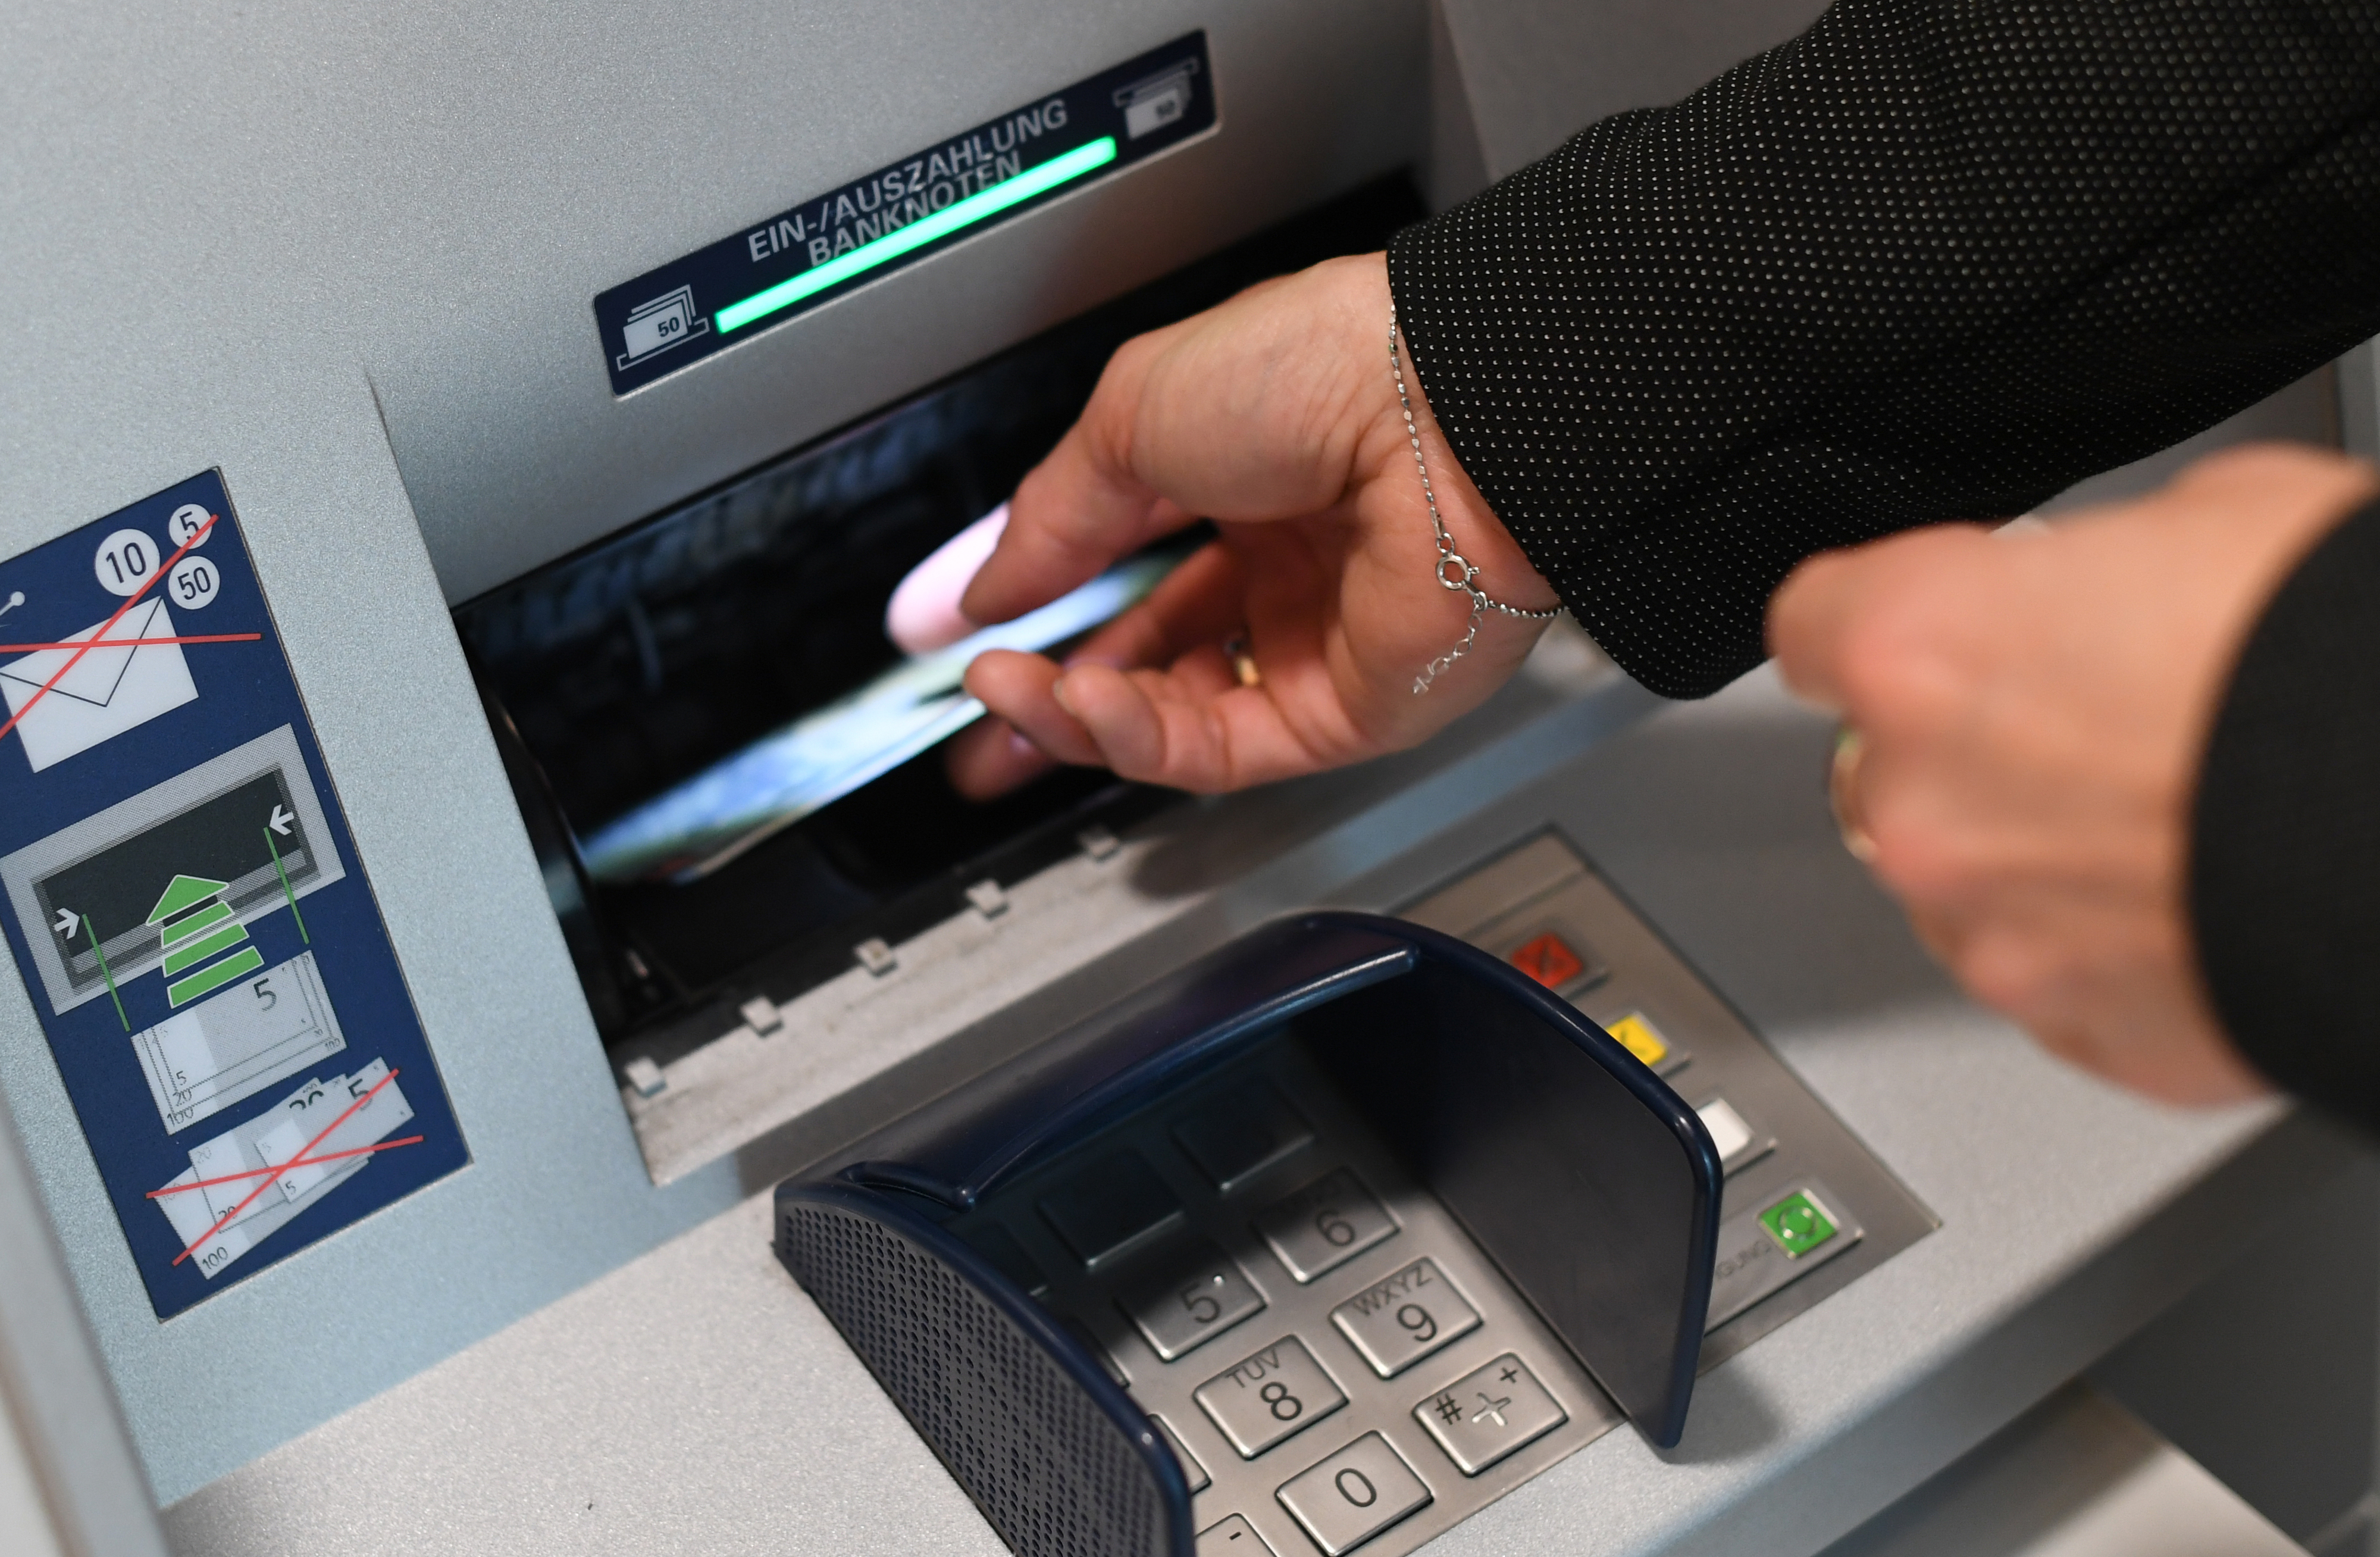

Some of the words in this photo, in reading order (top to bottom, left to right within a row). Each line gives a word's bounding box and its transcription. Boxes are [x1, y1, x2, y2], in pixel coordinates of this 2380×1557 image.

[747, 98, 1068, 263] EIN-/AUSZAHLUNG
[808, 149, 1021, 268] BANKNOTEN
[657, 317, 680, 338] 50
[179, 511, 200, 540] 5
[105, 542, 147, 583] 10
[177, 567, 211, 600] 50
[253, 978, 277, 1012] 5
[176, 1071, 187, 1086] 5
[348, 1078, 374, 1112] 5
[173, 1087, 192, 1107] 20
[167, 1106, 194, 1127] 100
[285, 1180, 297, 1195] 5
[1315, 1209, 1356, 1247] 6
[202, 1246, 228, 1270] 100
[1182, 1283, 1221, 1324] 5
[1353, 1264, 1433, 1317] WXYZ
[1396, 1303, 1438, 1342] 9
[1226, 1349, 1281, 1389] TUV
[1260, 1381, 1302, 1421] 8
[1335, 1467, 1377, 1508] 0
